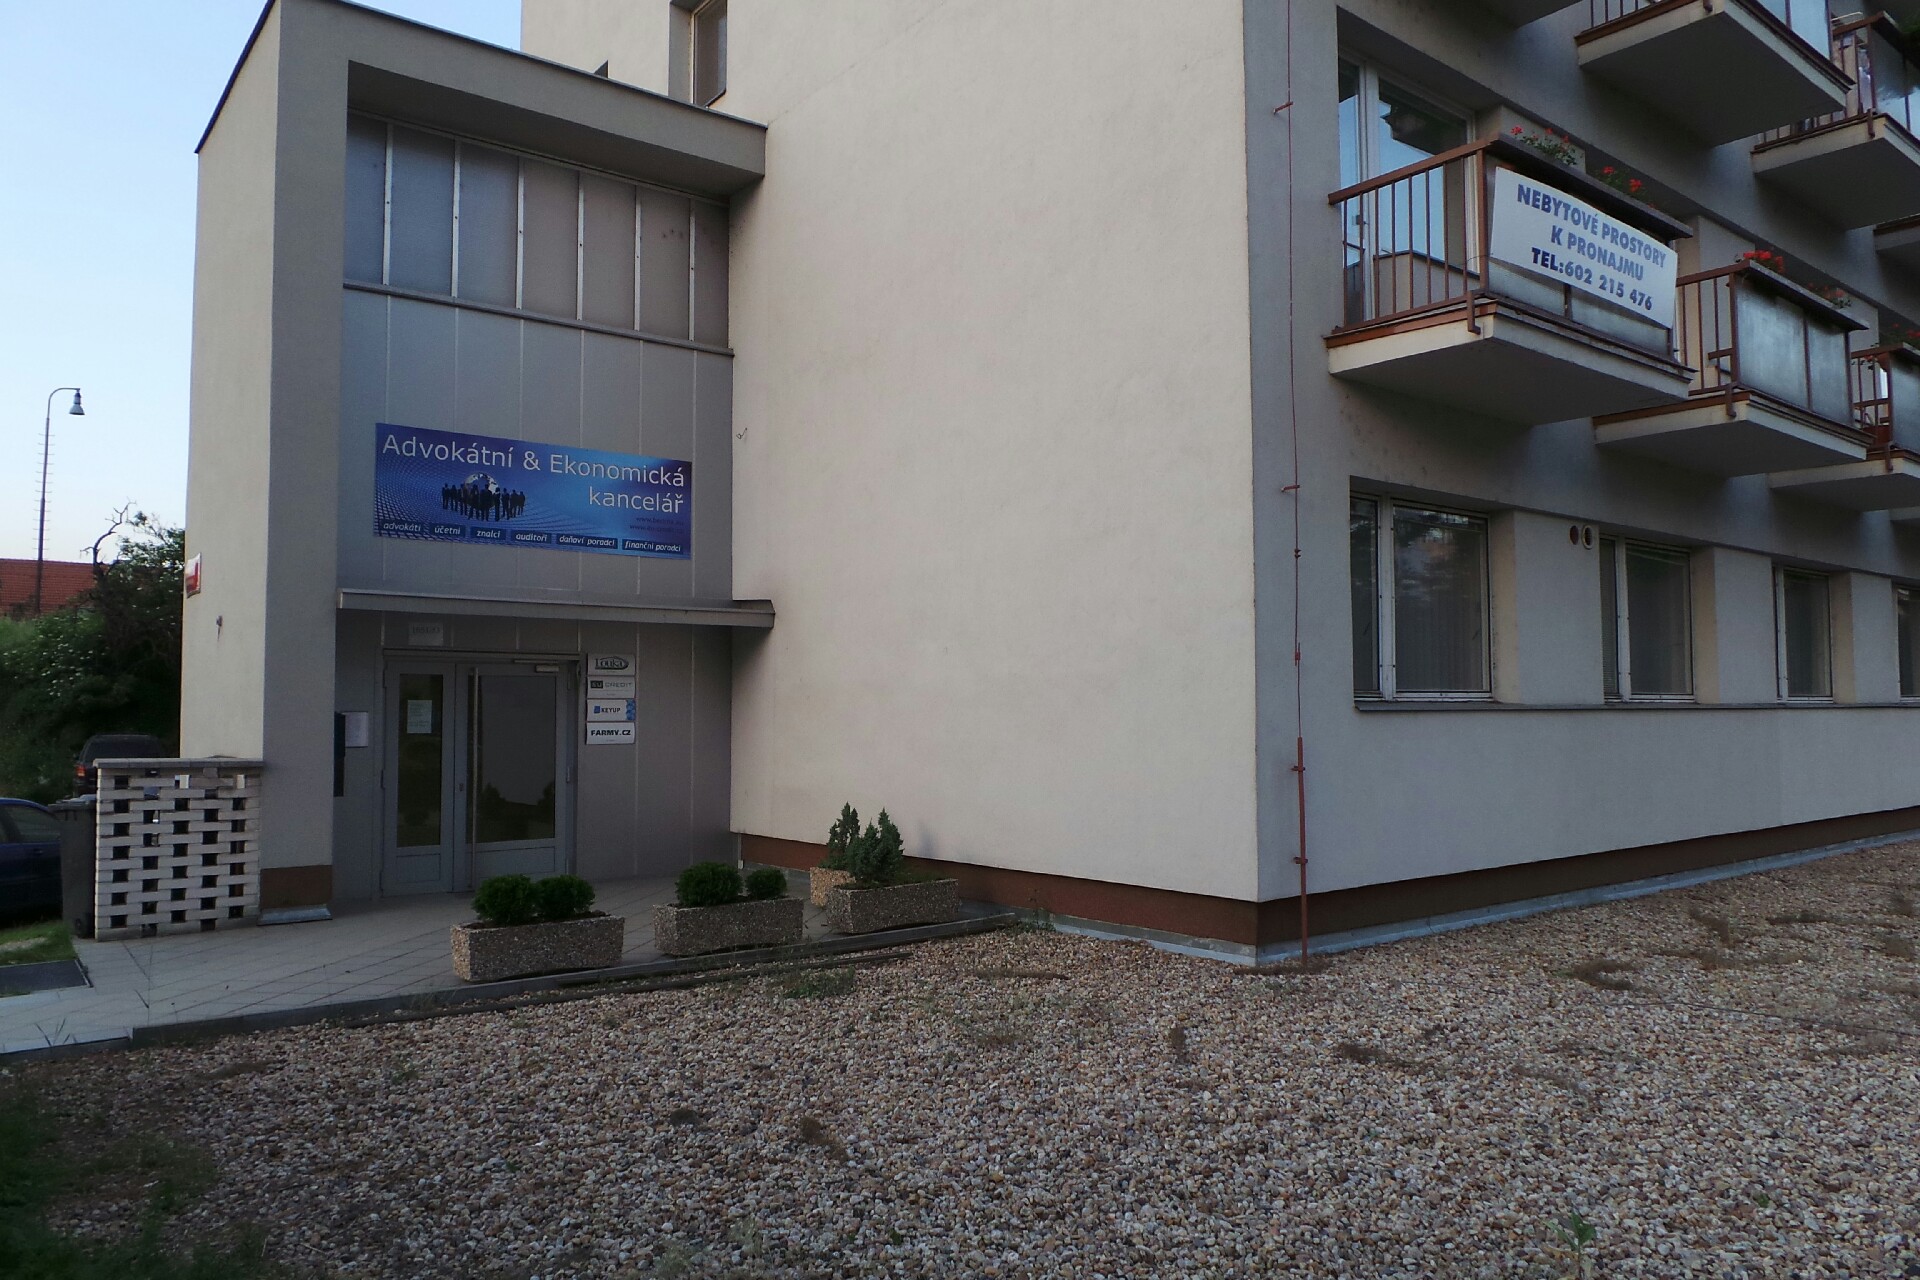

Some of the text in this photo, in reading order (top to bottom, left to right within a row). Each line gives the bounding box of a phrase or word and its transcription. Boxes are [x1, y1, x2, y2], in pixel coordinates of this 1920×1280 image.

[1517, 183, 1667, 268] NEBYTOVÉ PROSTORY
[1551, 225, 1644, 281] K PRONAJMU
[1531, 247, 1653, 311] TEL:602 215 476
[382, 434, 685, 487] Advokátní & Ekonomická
[588, 486, 684, 514] kancelář
[476, 529, 501, 538] znalci
[586, 538, 615, 547] poradci
[655, 544, 681, 553] poradci
